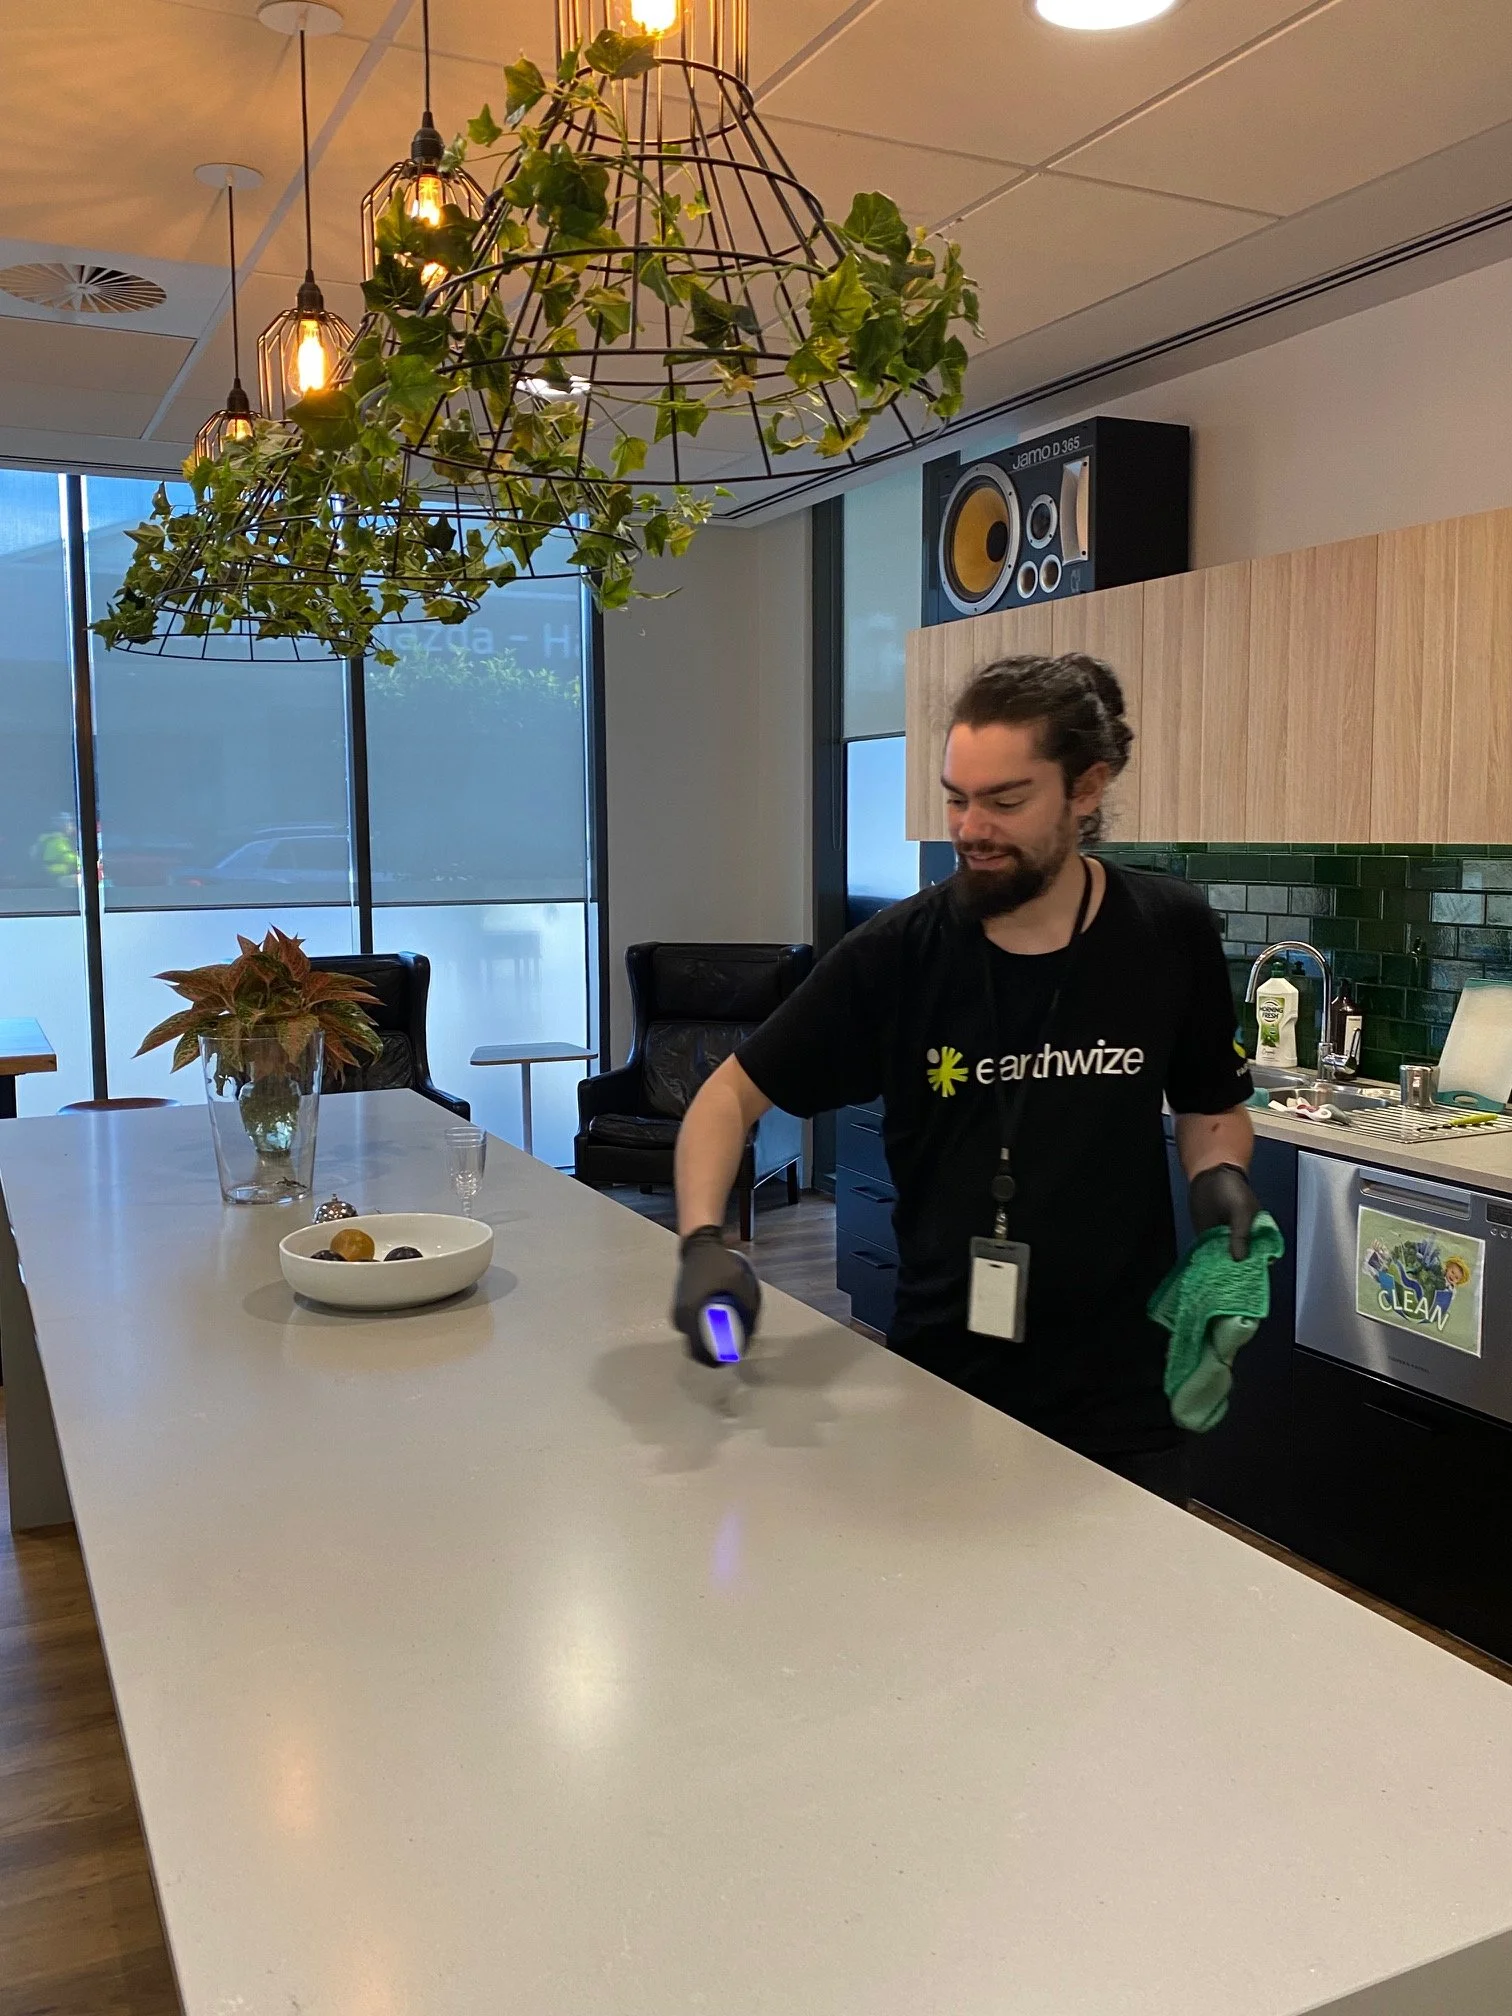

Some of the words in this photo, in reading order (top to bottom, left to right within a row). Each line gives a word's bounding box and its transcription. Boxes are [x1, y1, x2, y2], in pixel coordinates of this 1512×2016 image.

[1052, 442, 1060, 456] D
[1061, 435, 1080, 453] 365
[975, 1038, 1145, 1085] earthwize
[1378, 1289, 1449, 1331] CLEAN
